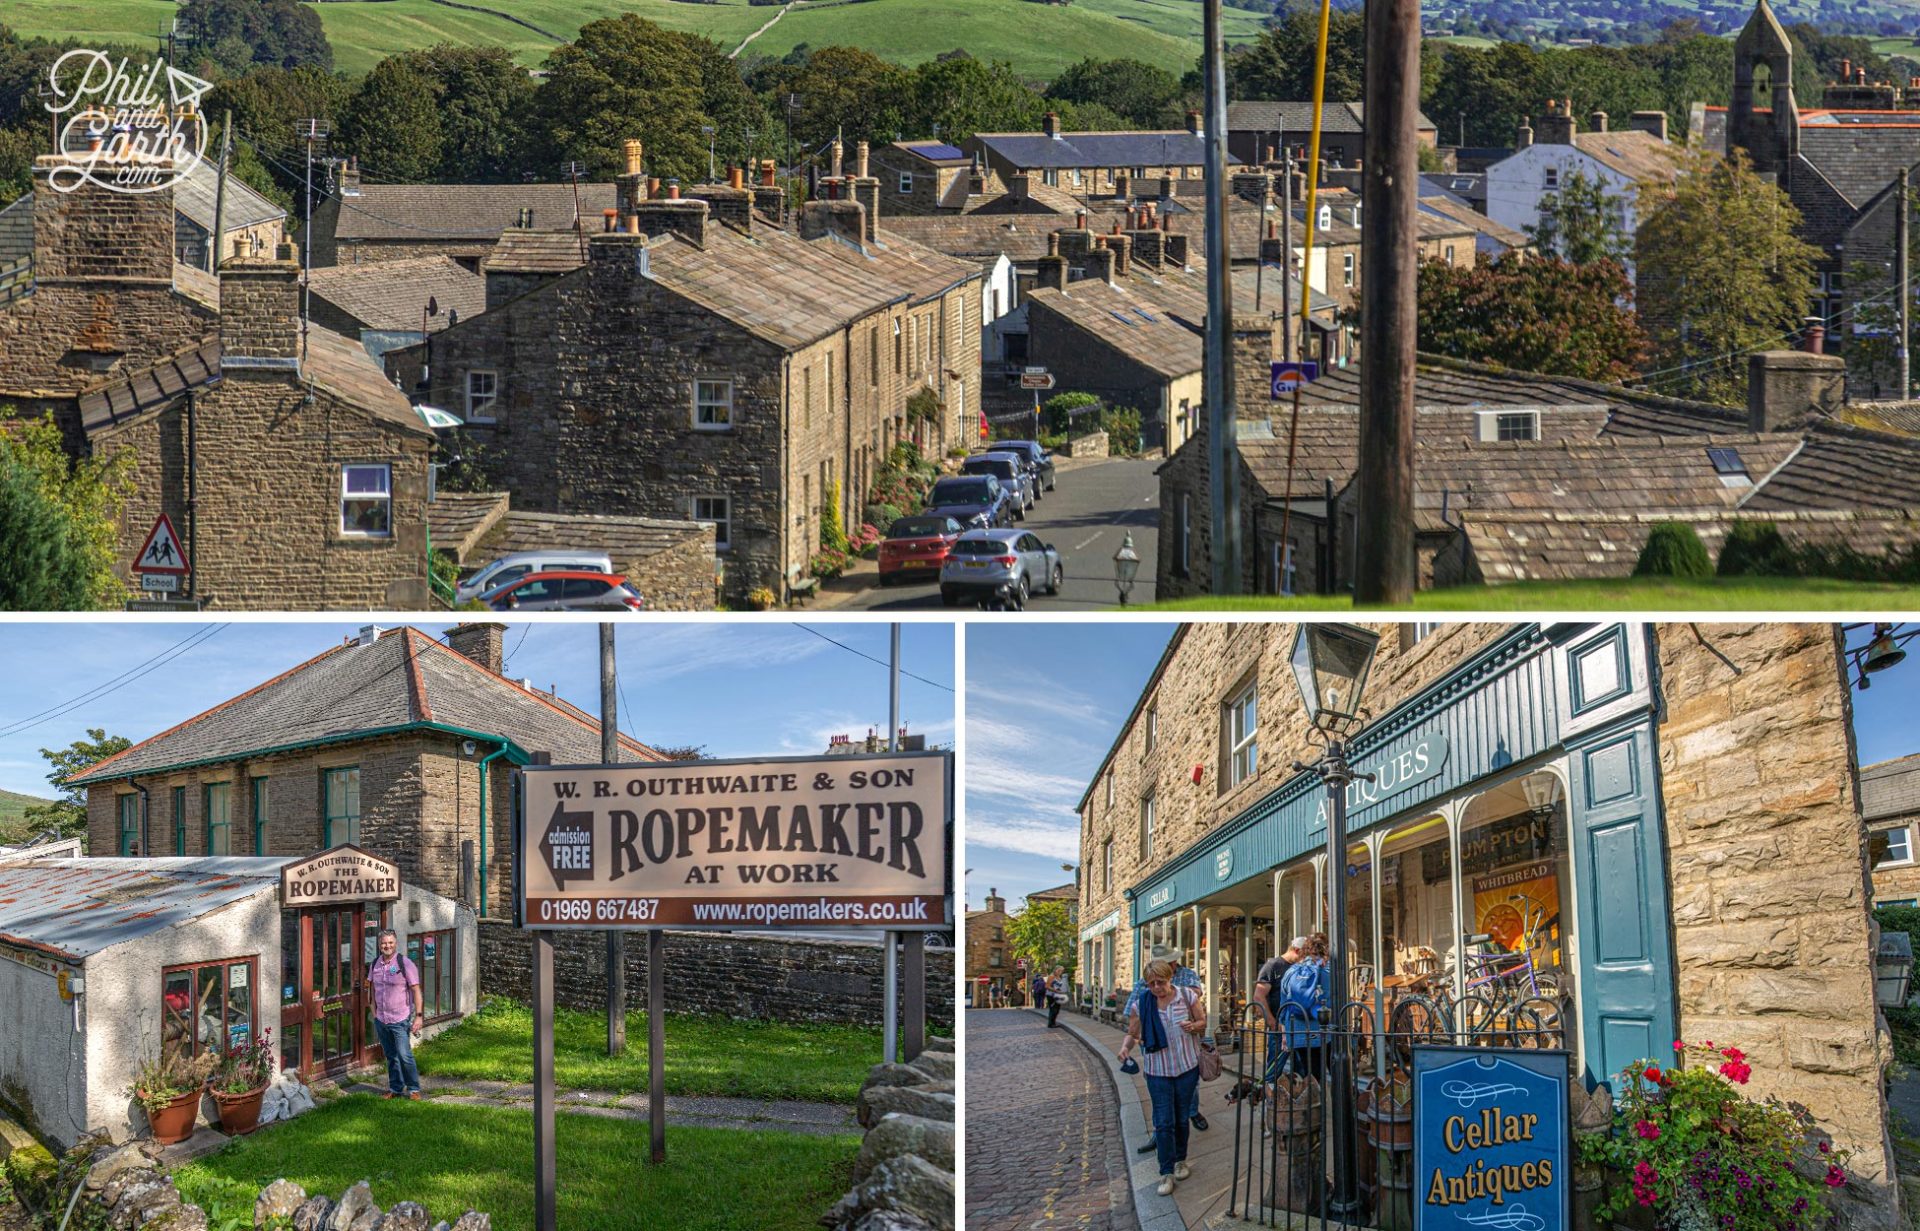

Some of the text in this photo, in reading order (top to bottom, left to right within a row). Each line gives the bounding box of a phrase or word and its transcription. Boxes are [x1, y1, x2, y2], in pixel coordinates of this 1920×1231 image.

[145, 577, 174, 588] School
[553, 768, 915, 799] W. R. OUTHWAITE & SON
[1314, 742, 1430, 825] ATIQUES
[548, 825, 591, 845] admission
[608, 801, 927, 882] ROPEMAKER
[1441, 821, 1546, 866] PUMPTON
[296, 856, 390, 878] W. R. OUTHWAITE & SON
[552, 845, 591, 870] FREE
[333, 867, 359, 877] THE
[684, 863, 840, 884] AT WORK
[1478, 865, 1548, 891] WHITBREAD
[290, 877, 396, 898] ROPEMAKER
[1150, 887, 1170, 908] CELLAR
[540, 898, 660, 921] 01969 667487
[692, 896, 928, 925] www.ropemakers.co.uk
[1444, 1106, 1538, 1153] Cellar
[1426, 1158, 1553, 1205] Antiques
